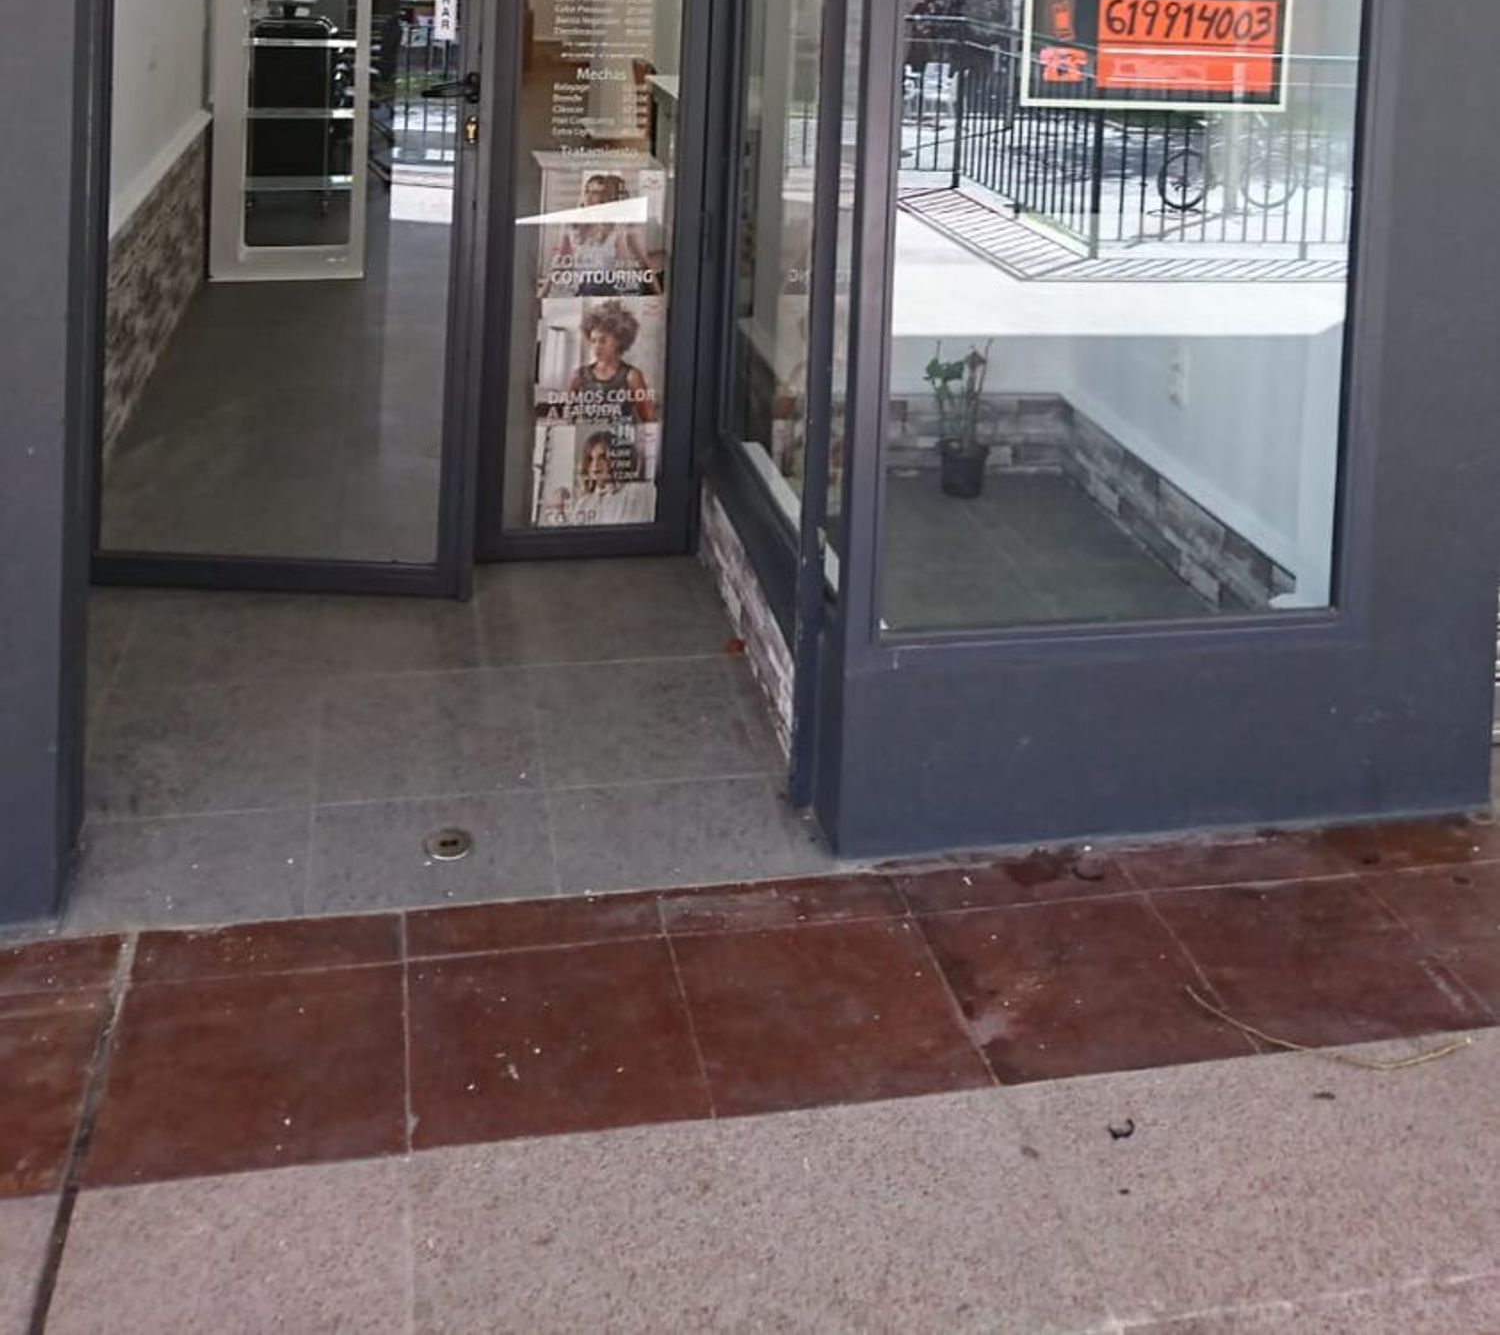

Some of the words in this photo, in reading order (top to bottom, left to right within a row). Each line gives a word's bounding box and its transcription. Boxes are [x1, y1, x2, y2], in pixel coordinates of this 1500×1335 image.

[576, 67, 627, 81] Mechas
[551, 269, 653, 285] CONTOURING
[548, 390, 604, 405] DAMOS
[606, 388, 656, 403] COLOR
